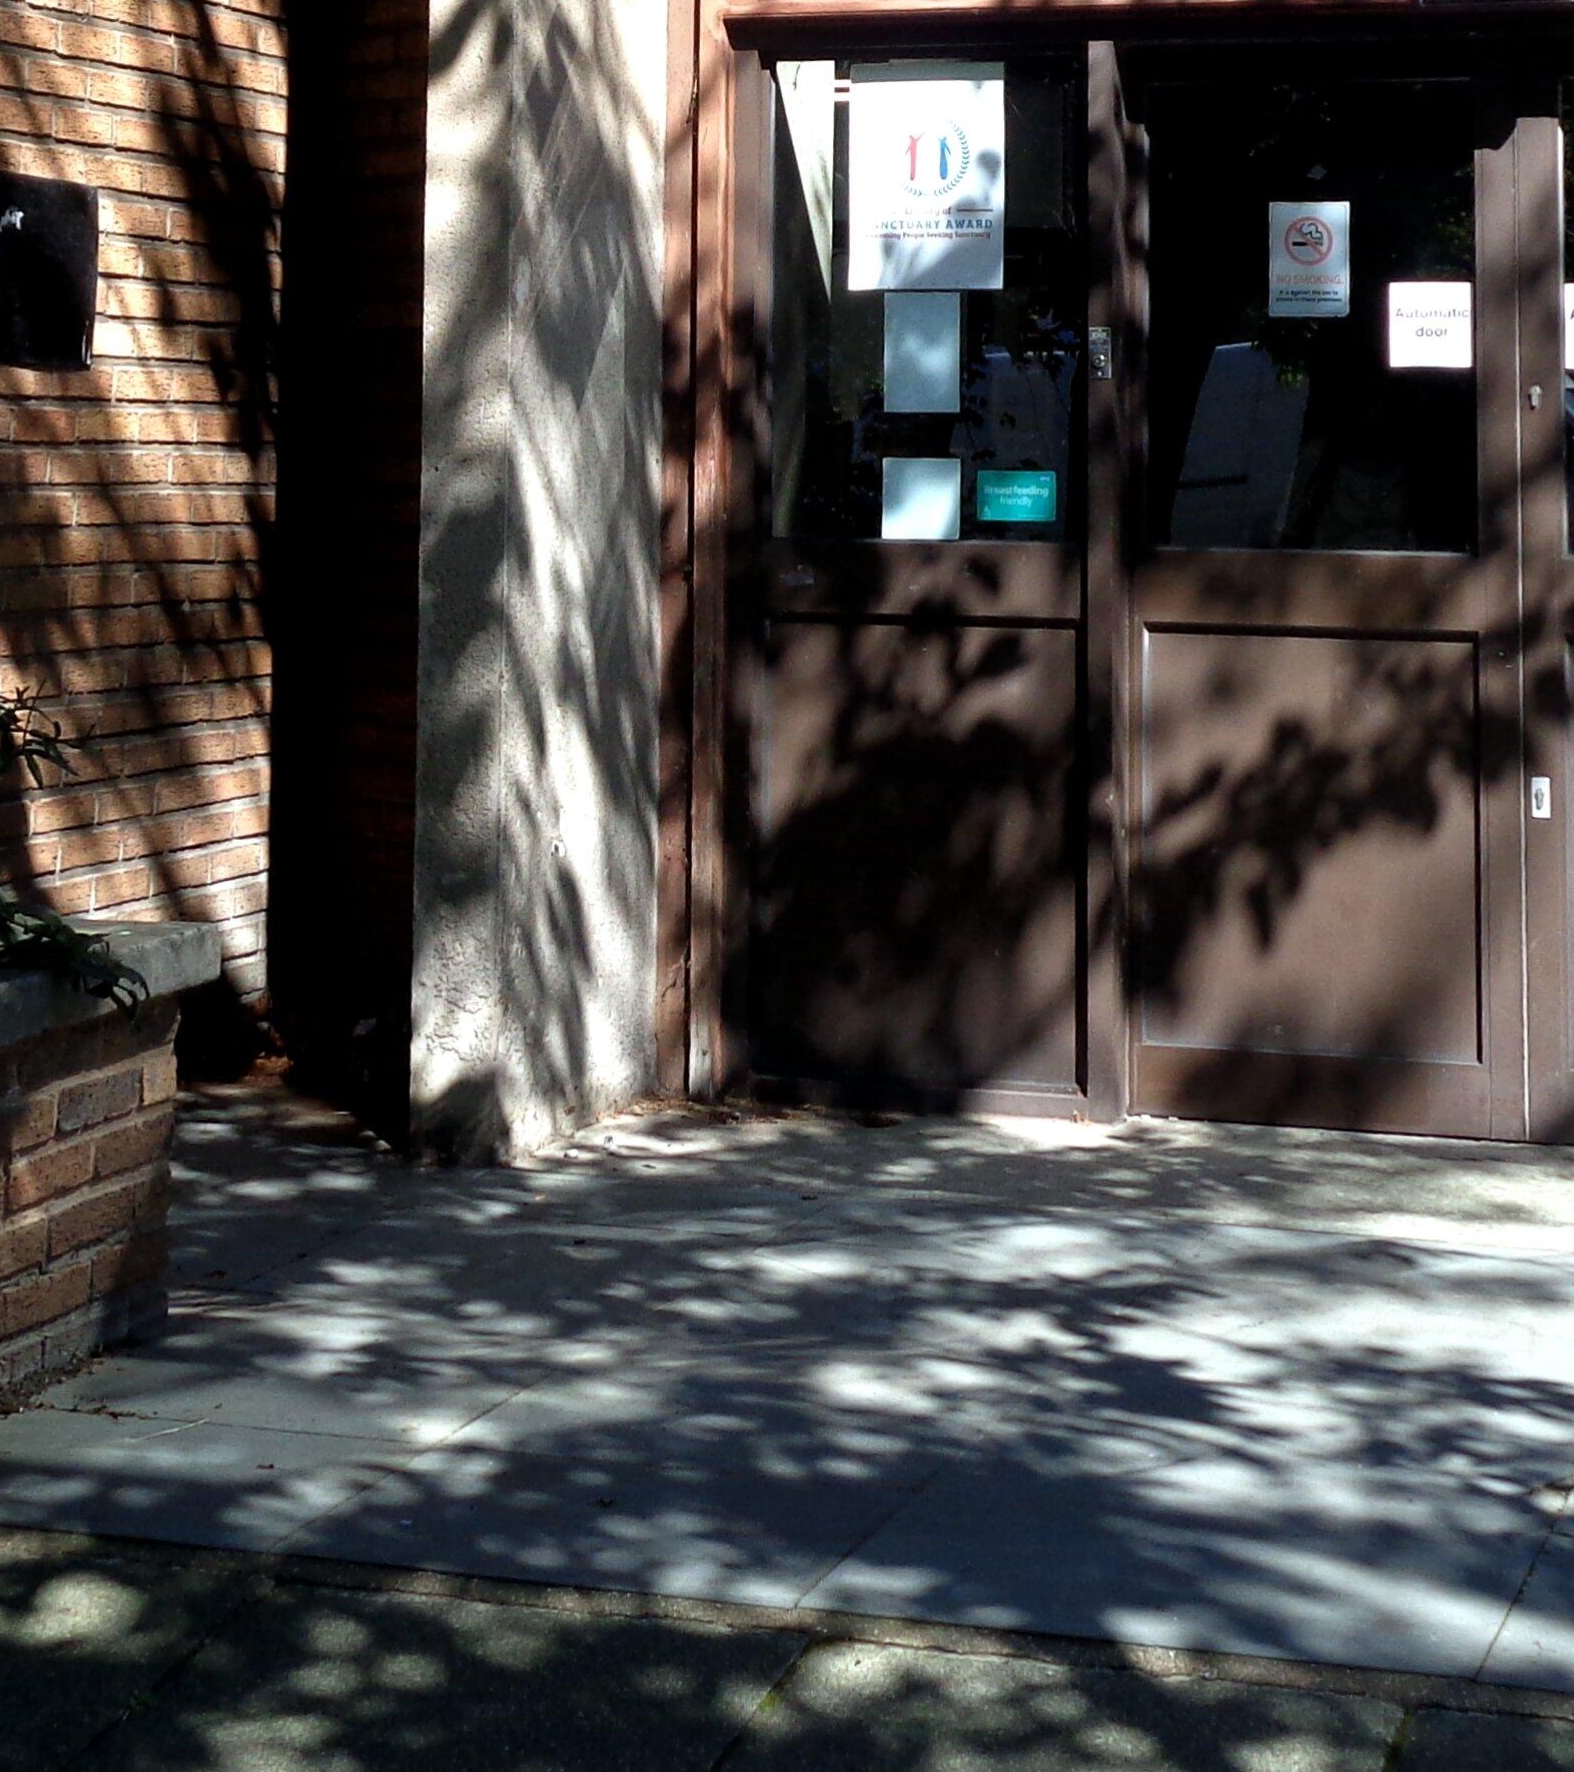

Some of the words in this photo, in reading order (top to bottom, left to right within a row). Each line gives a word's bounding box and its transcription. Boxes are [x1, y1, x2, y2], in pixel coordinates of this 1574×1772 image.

[945, 218, 994, 230] AWARD
[1395, 307, 1471, 319] Automatic
[1415, 326, 1448, 338] door
